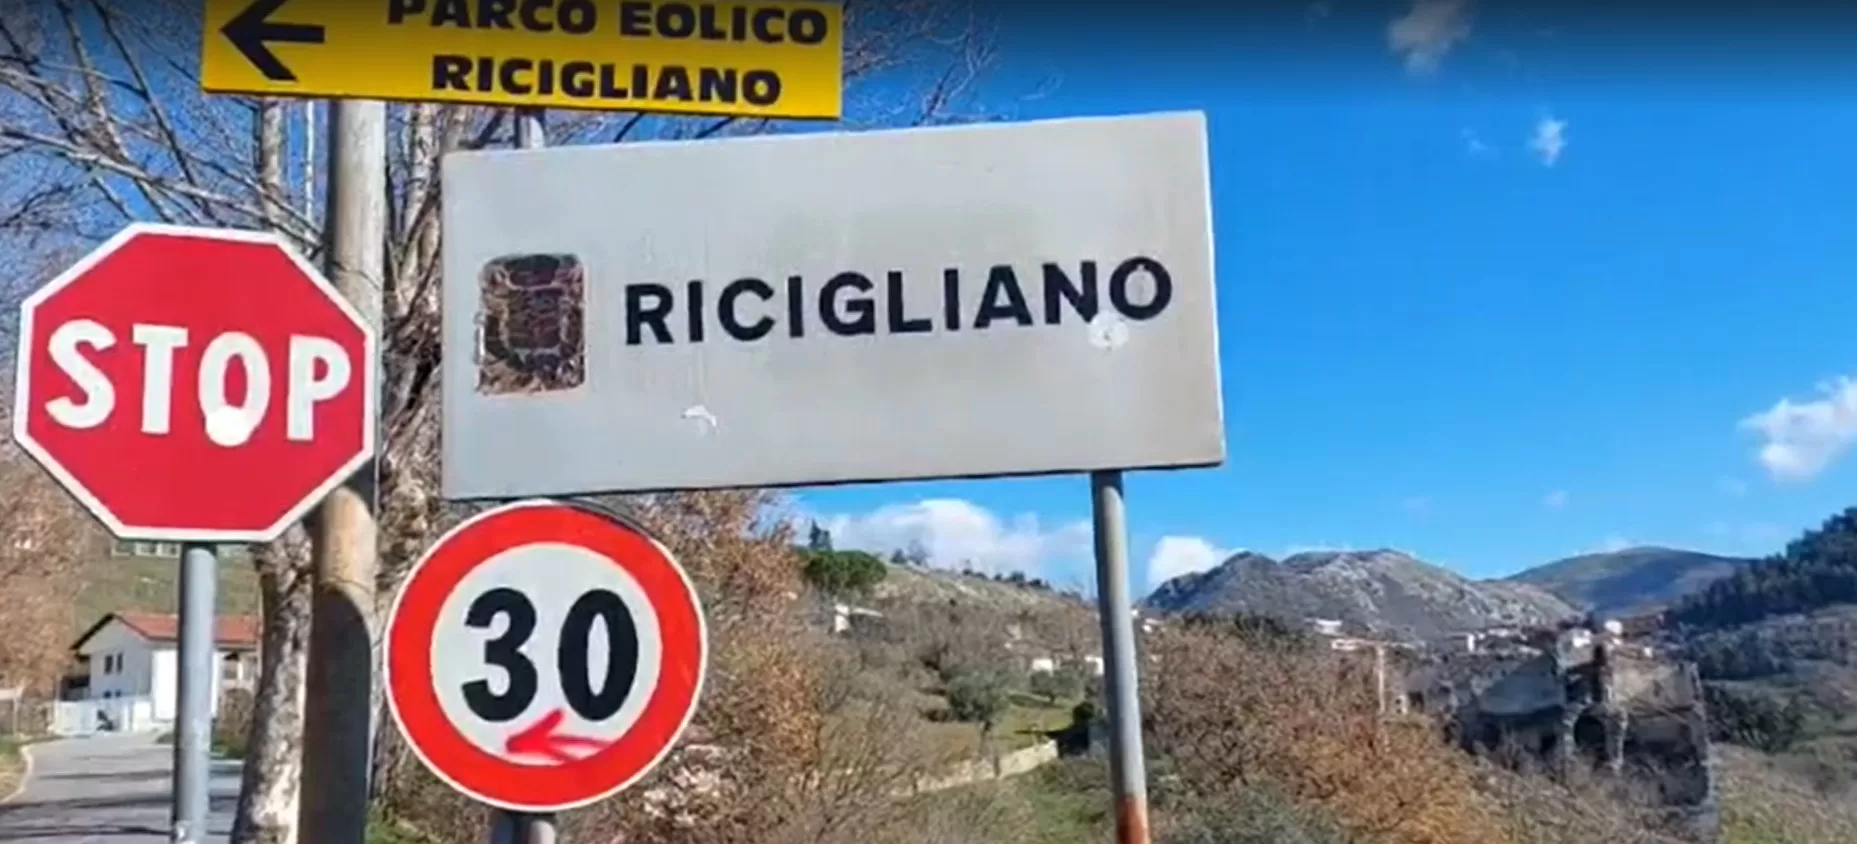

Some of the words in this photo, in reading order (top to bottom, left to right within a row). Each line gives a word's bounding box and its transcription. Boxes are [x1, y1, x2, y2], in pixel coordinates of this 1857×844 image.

[387, 0, 597, 36] PARCO
[618, 0, 829, 45] EOLICO
[431, 54, 783, 106] RICIGLIANO
[624, 256, 1173, 345] RICIGLIANO
[45, 319, 351, 446] STOP
[461, 587, 639, 722] 30
